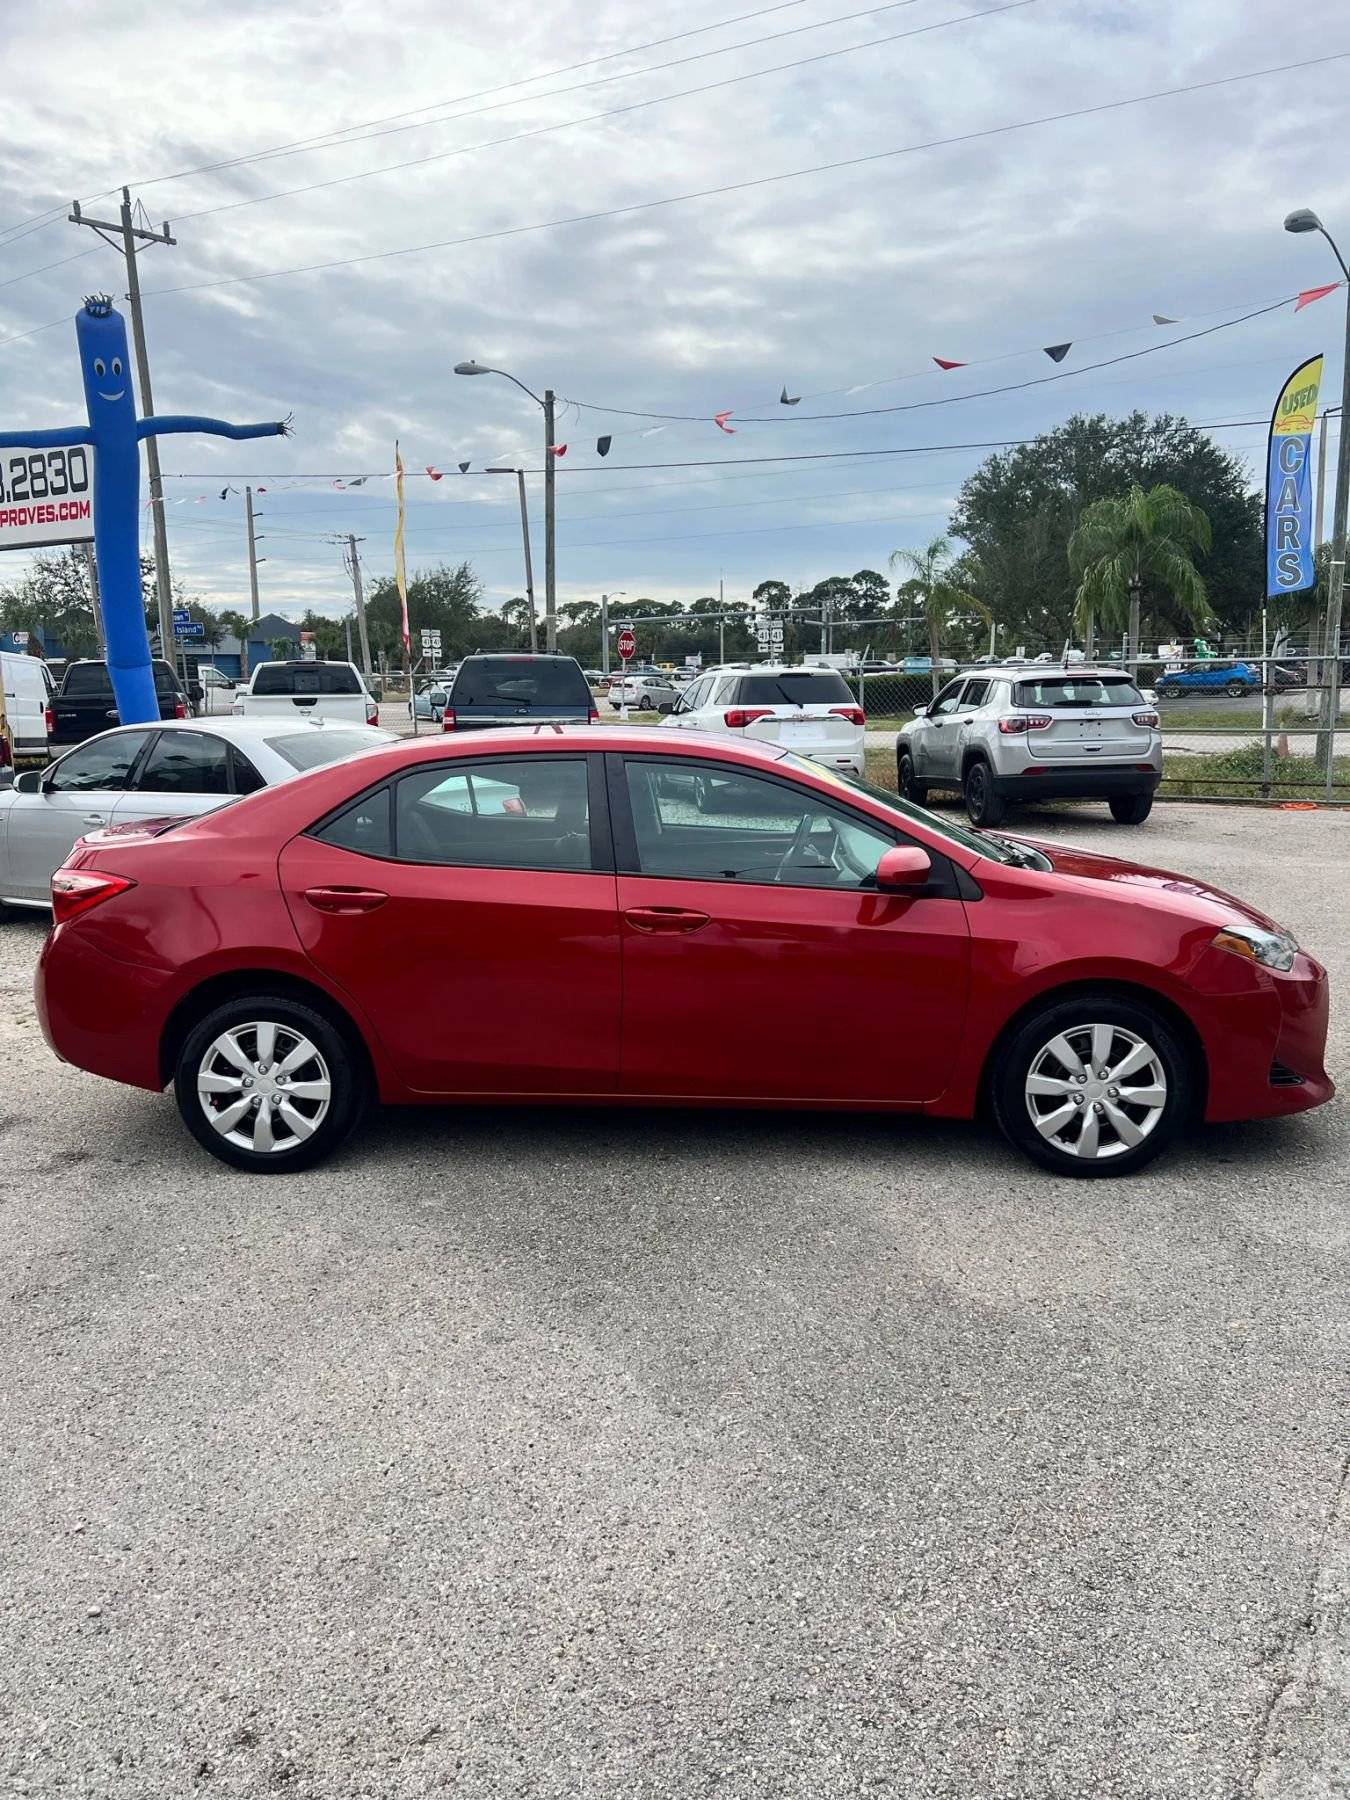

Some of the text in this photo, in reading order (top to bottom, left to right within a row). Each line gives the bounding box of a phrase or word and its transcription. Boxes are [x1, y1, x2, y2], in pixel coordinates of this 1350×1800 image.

[1281, 383, 1318, 416] USED
[1275, 436, 1304, 587] CARS
[176, 626, 197, 634] Island
[759, 631, 782, 640] 41 41
[619, 640, 635, 651] STOP
